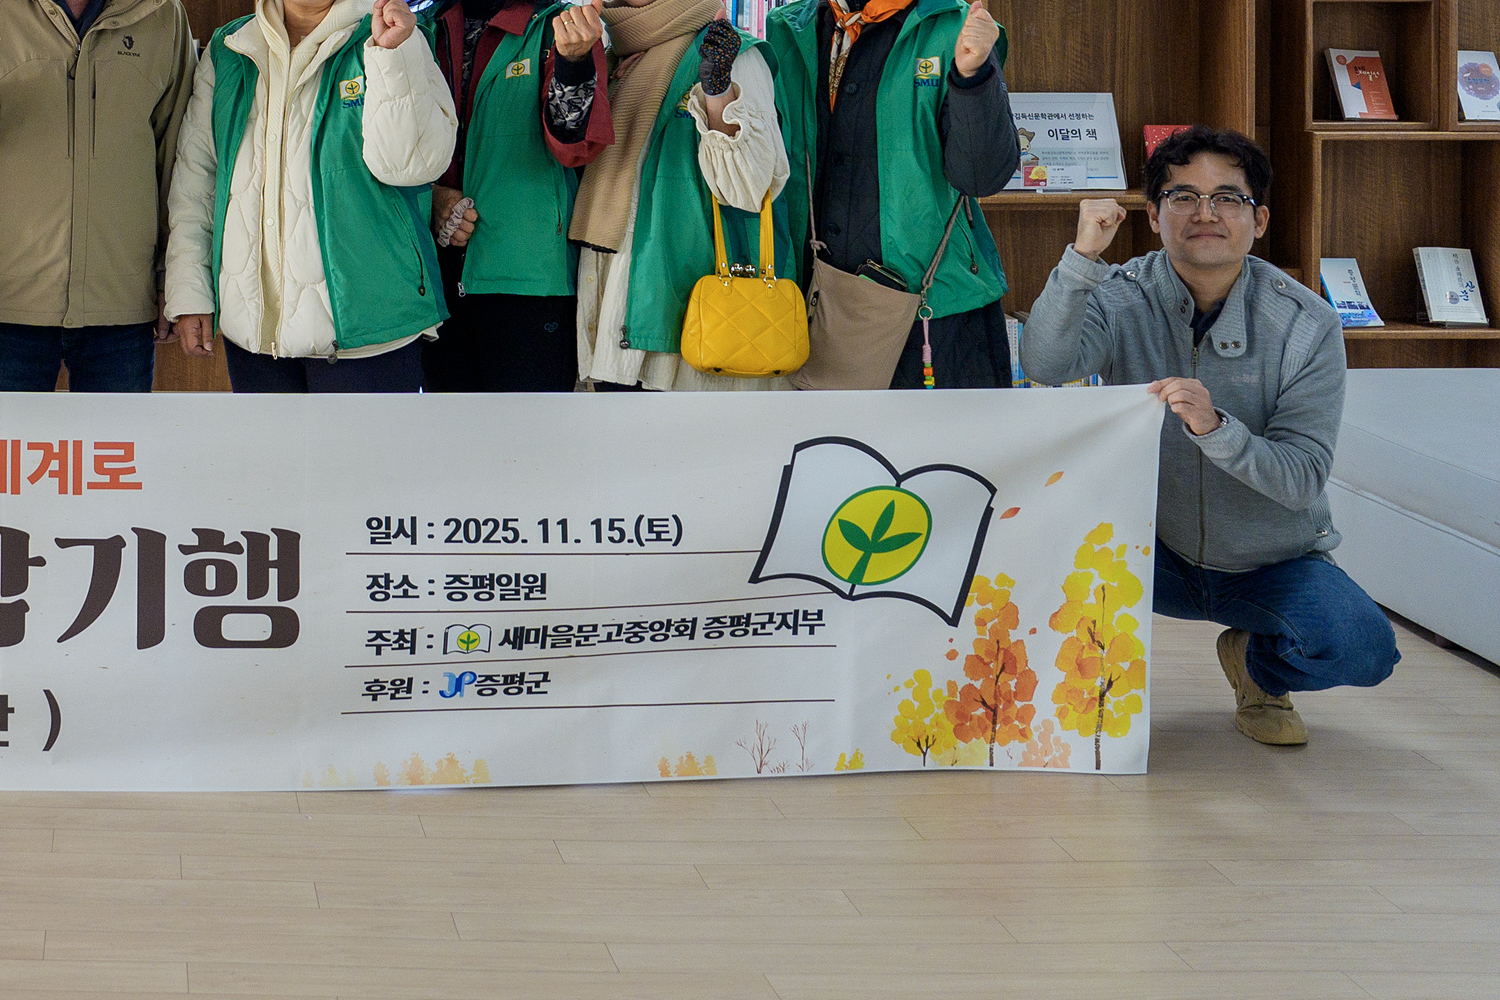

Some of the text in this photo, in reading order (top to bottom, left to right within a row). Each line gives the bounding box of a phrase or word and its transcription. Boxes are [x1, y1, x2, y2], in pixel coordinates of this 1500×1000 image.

[914, 79, 939, 88] SMU
[1047, 128, 1097, 140] 이달의 책
[365, 516, 417, 545] 일시
[365, 573, 420, 602] 장소
[443, 573, 547, 602] 증평일원
[364, 628, 417, 656] 주최
[497, 617, 698, 651] 새마을문고중앙회
[702, 609, 826, 640] 증평군지부
[361, 677, 414, 702] 후원
